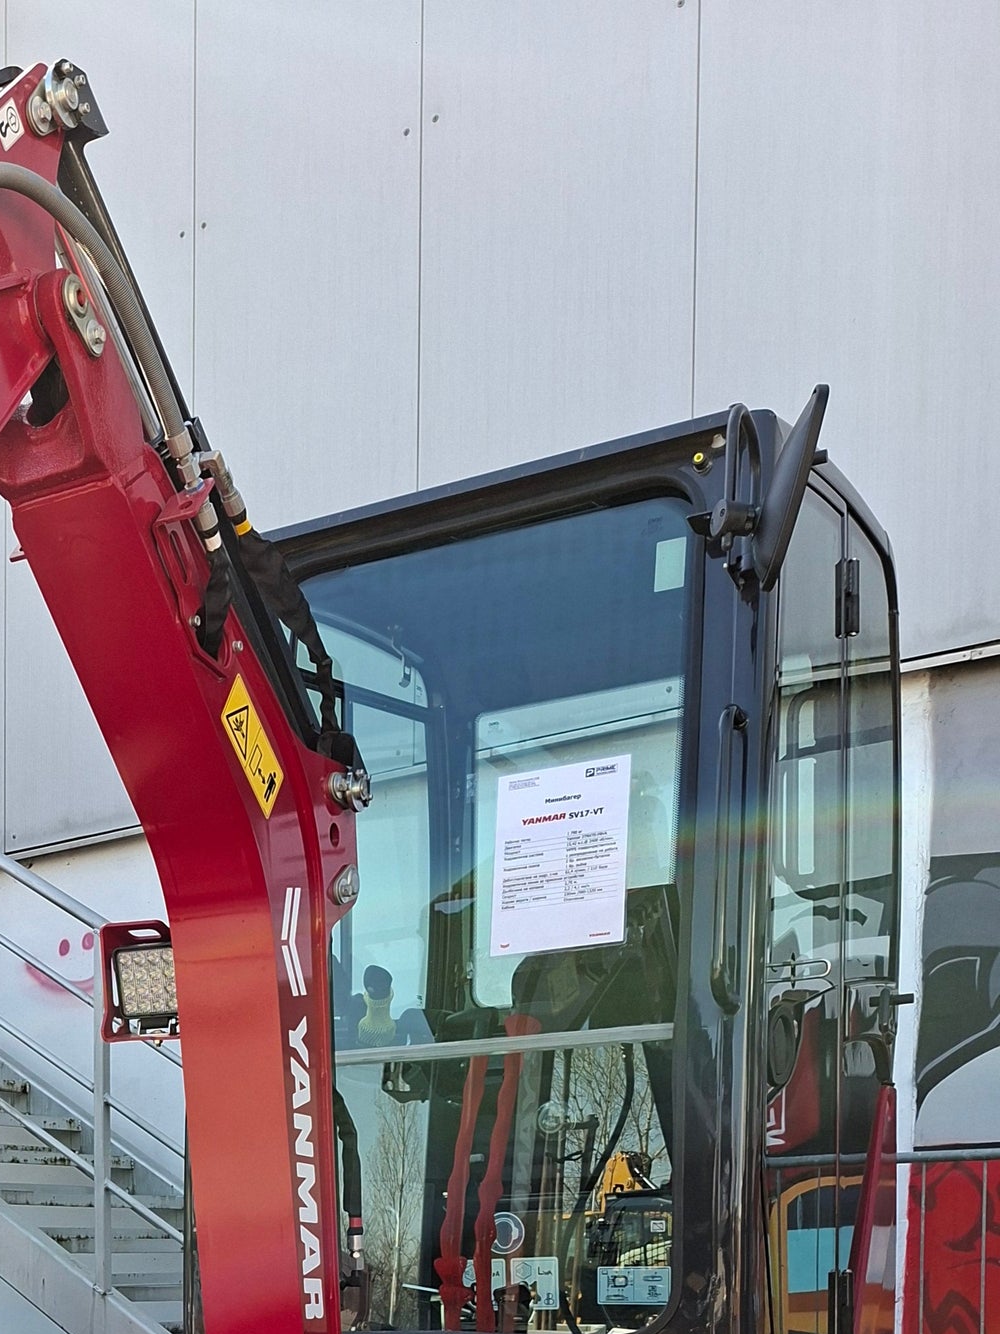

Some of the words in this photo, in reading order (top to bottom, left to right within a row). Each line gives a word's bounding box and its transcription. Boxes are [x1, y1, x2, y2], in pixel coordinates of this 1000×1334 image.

[522, 812, 567, 826] YANMAR
[568, 807, 604, 819] SV17-VT
[288, 1015, 324, 1320] YANMAR
